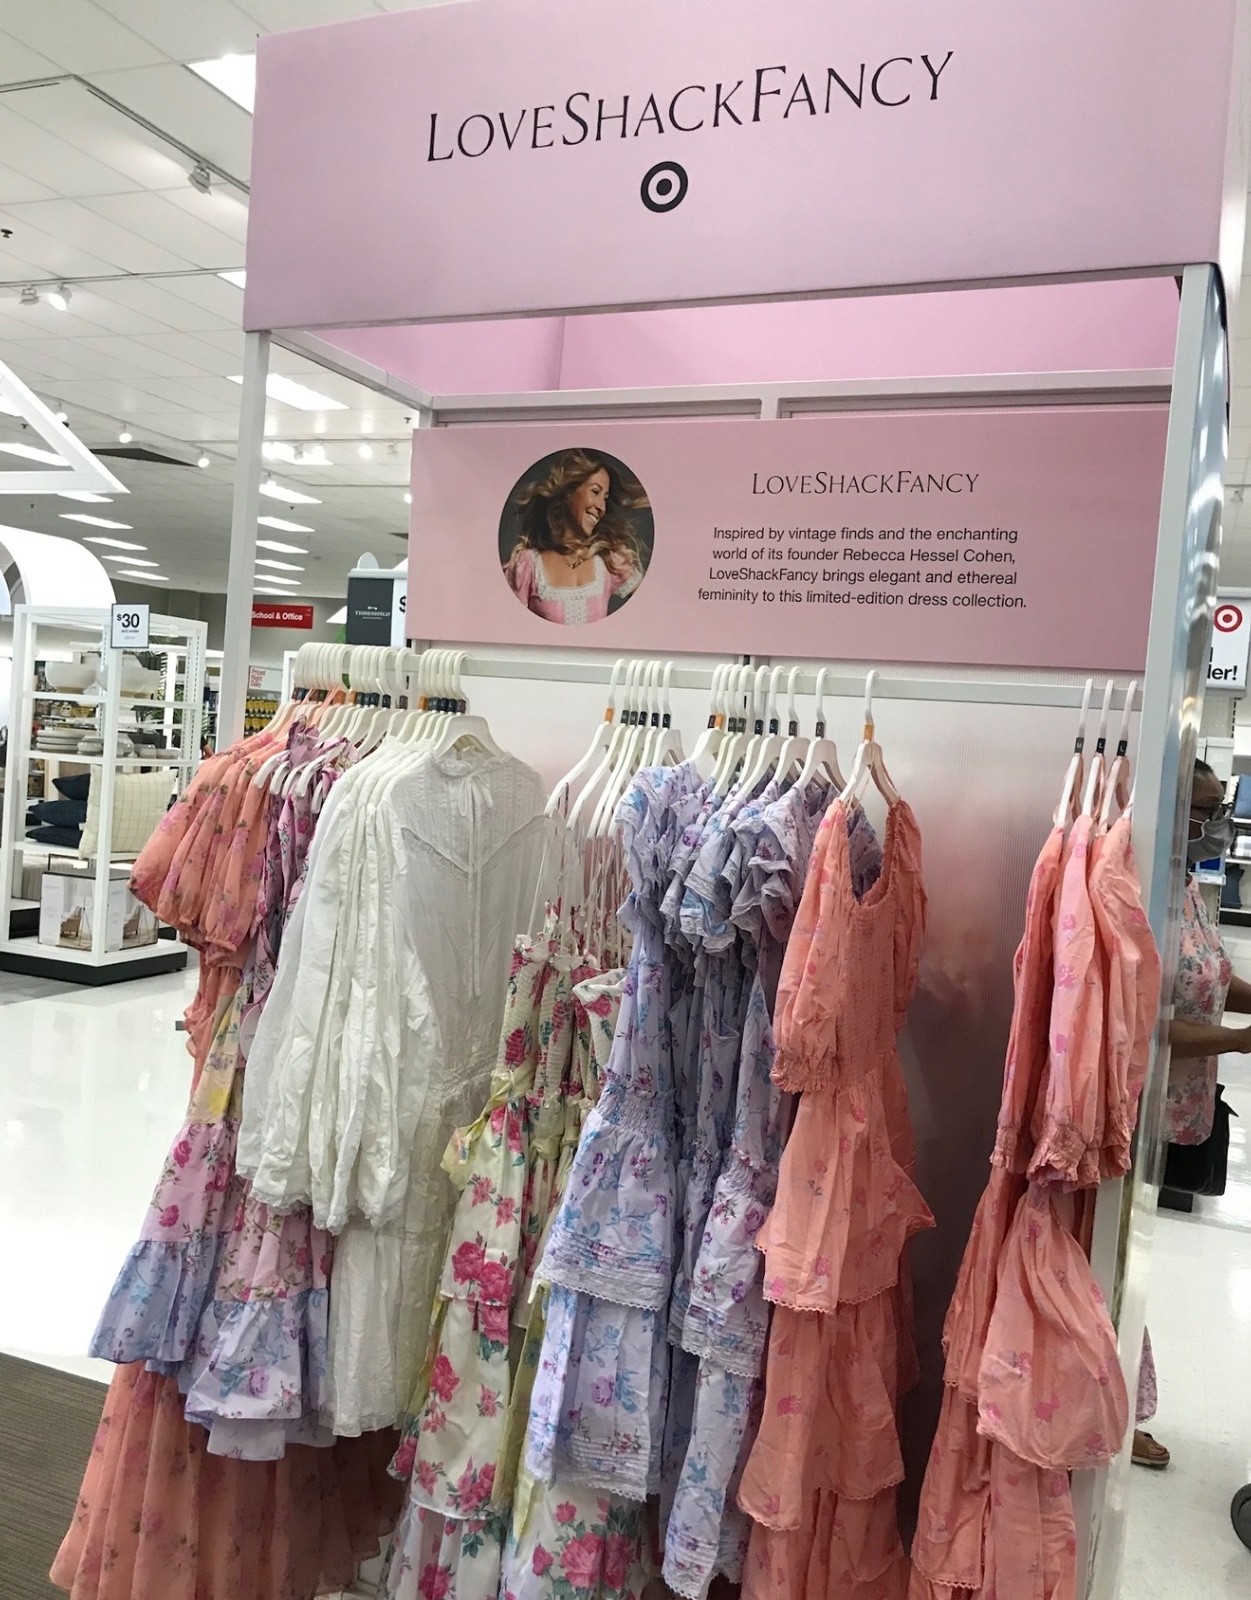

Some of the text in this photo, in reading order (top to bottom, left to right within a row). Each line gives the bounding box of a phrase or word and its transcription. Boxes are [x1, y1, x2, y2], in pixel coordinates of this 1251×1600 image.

[714, 527, 1018, 543] Inspired by vintage finds and the enchanting
[713, 547, 1015, 564] world of its founder Rebecca Hessel Cohen,
[710, 567, 1017, 586] LoveShackFancy brings elegant and ethereal
[698, 588, 1027, 608] femininity to this limited-edition dress collection.
[117, 613, 140, 628] $30
[275, 612, 281, 620] &
[282, 612, 303, 621] Office
